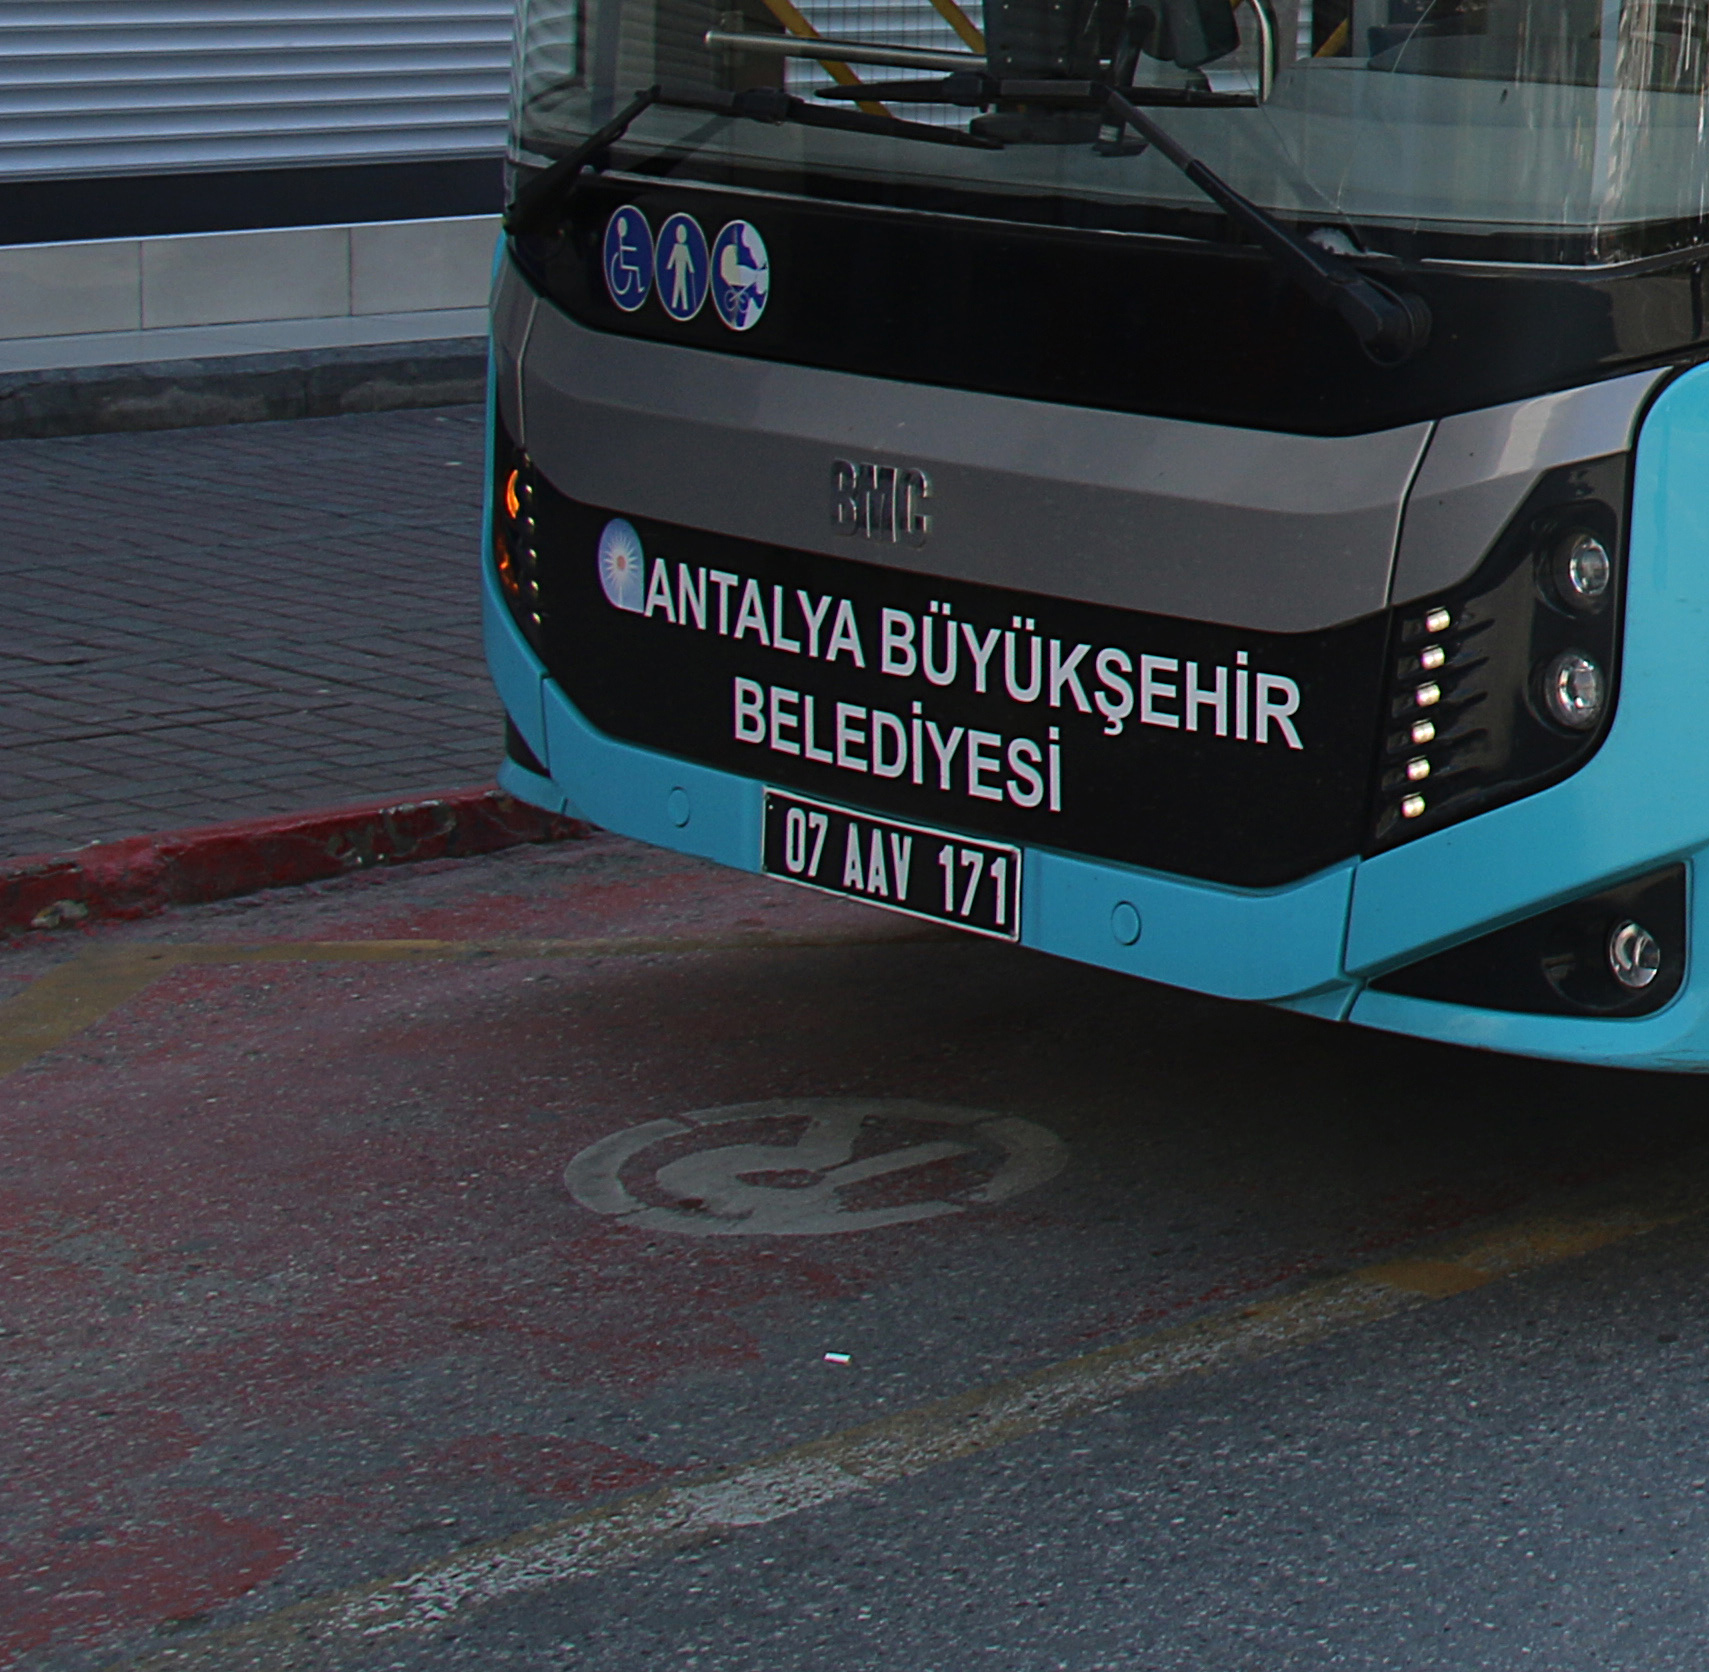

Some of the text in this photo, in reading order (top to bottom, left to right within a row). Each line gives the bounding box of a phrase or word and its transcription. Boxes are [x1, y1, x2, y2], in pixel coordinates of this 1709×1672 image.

[829, 458, 934, 551] BMC
[643, 555, 1305, 752] ANTALYA BÜYÜKŞEHİR
[733, 674, 1063, 813] BELEDİYESİ
[784, 807, 1010, 926] 07 AAV 171
